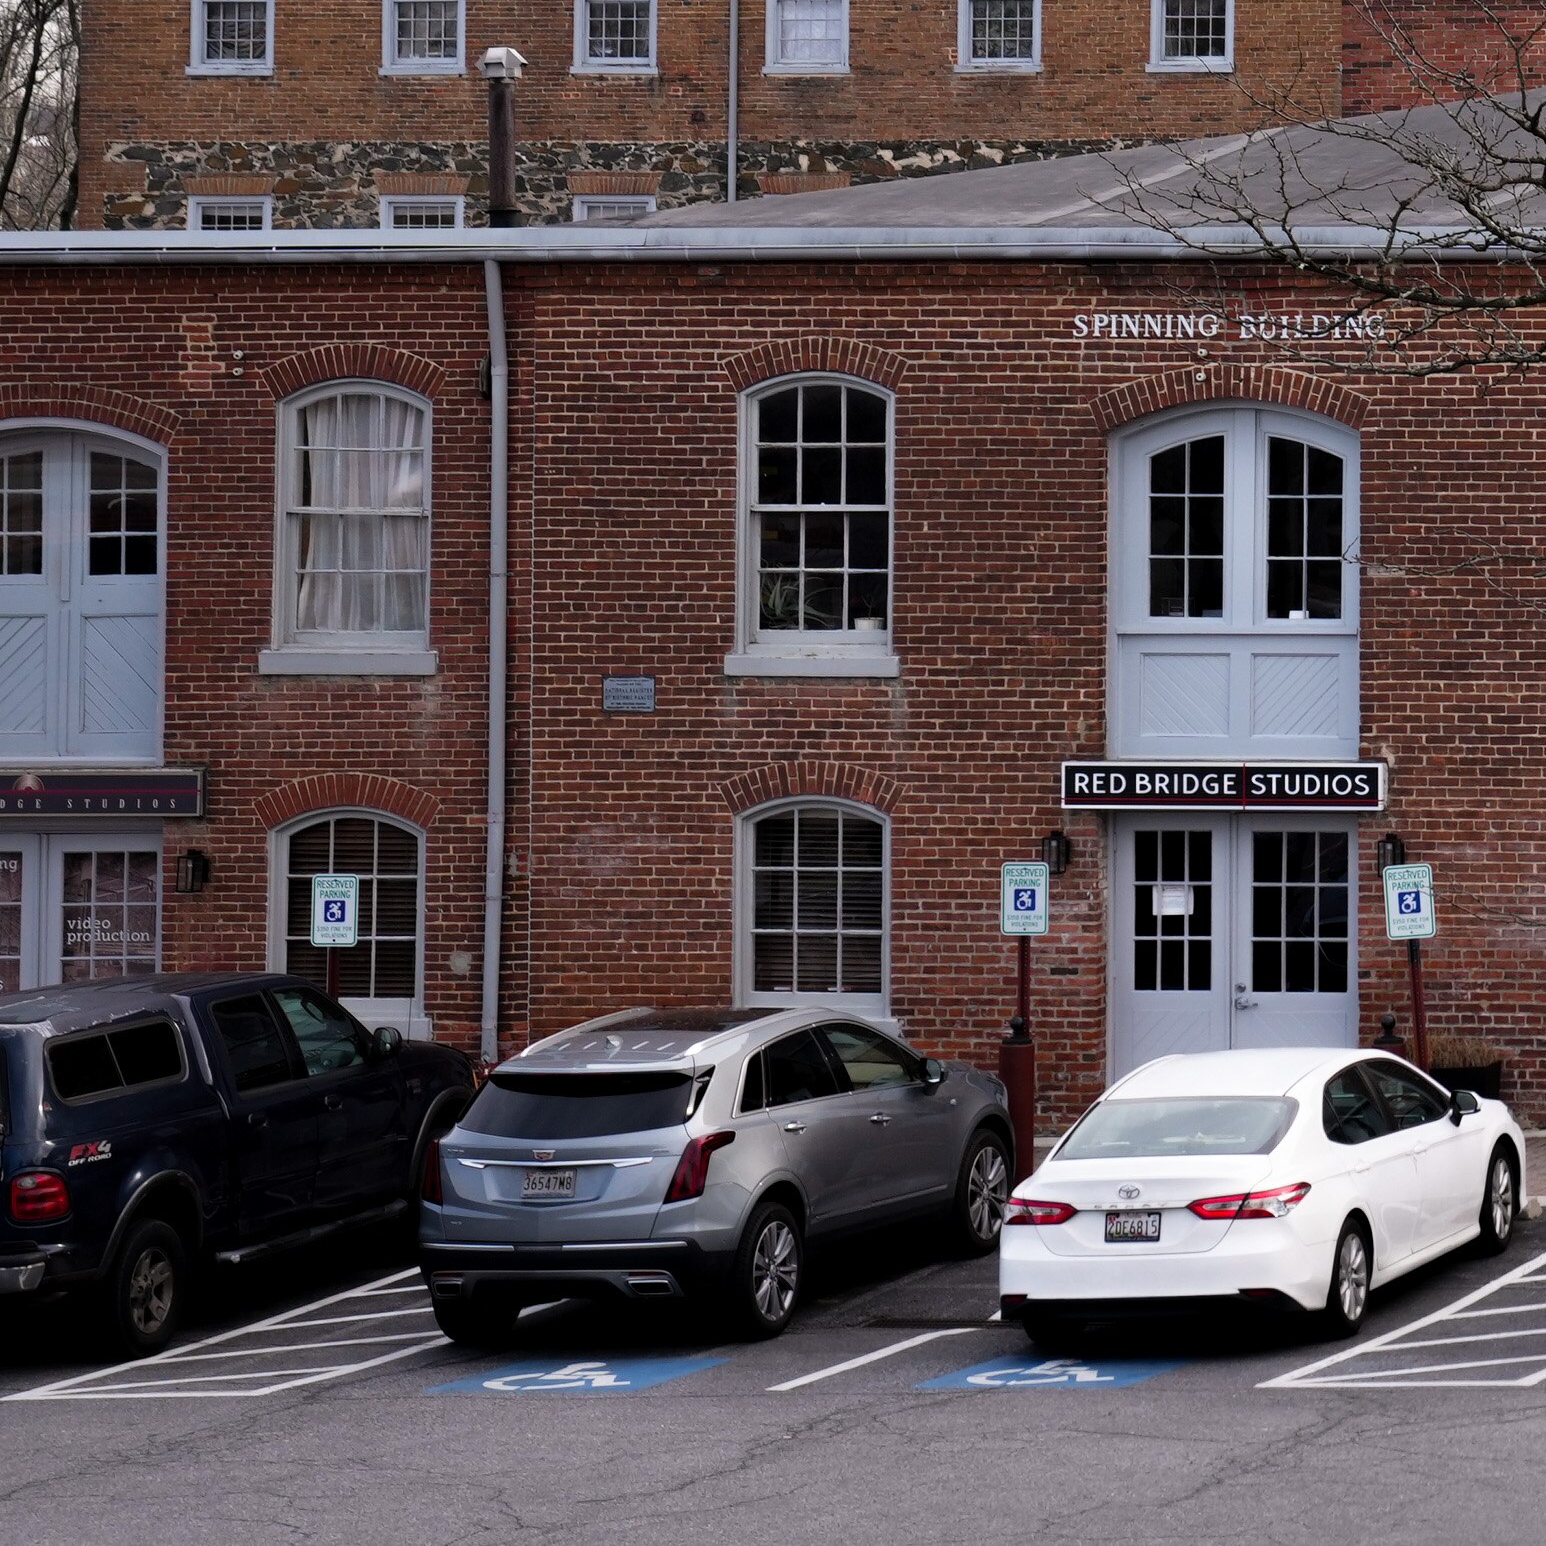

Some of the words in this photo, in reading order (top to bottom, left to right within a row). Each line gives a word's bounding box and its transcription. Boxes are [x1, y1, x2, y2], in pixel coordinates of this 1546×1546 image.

[1072, 313, 1219, 339] SPINNING
[1239, 313, 1385, 340] BUILDING
[1073, 773, 1127, 795] RED
[1135, 773, 1237, 795] BRIDGE
[1250, 773, 1371, 796] STUDIOS
[67, 798, 176, 810] STUDIOS
[1006, 868, 1044, 877] RESERVED
[1388, 870, 1428, 881] RESERVED
[317, 879, 355, 889] RESERVED
[1009, 879, 1041, 888] PARKING
[1391, 880, 1425, 891] PARKING
[320, 890, 351, 899] PARKING
[67, 917, 111, 929] video
[67, 930, 151, 944] production
[70, 1140, 112, 1160] FX4
[68, 1158, 86, 1167] OFF
[87, 1152, 112, 1162] ROAD
[1107, 1220, 1157, 1237] 2DE6815
